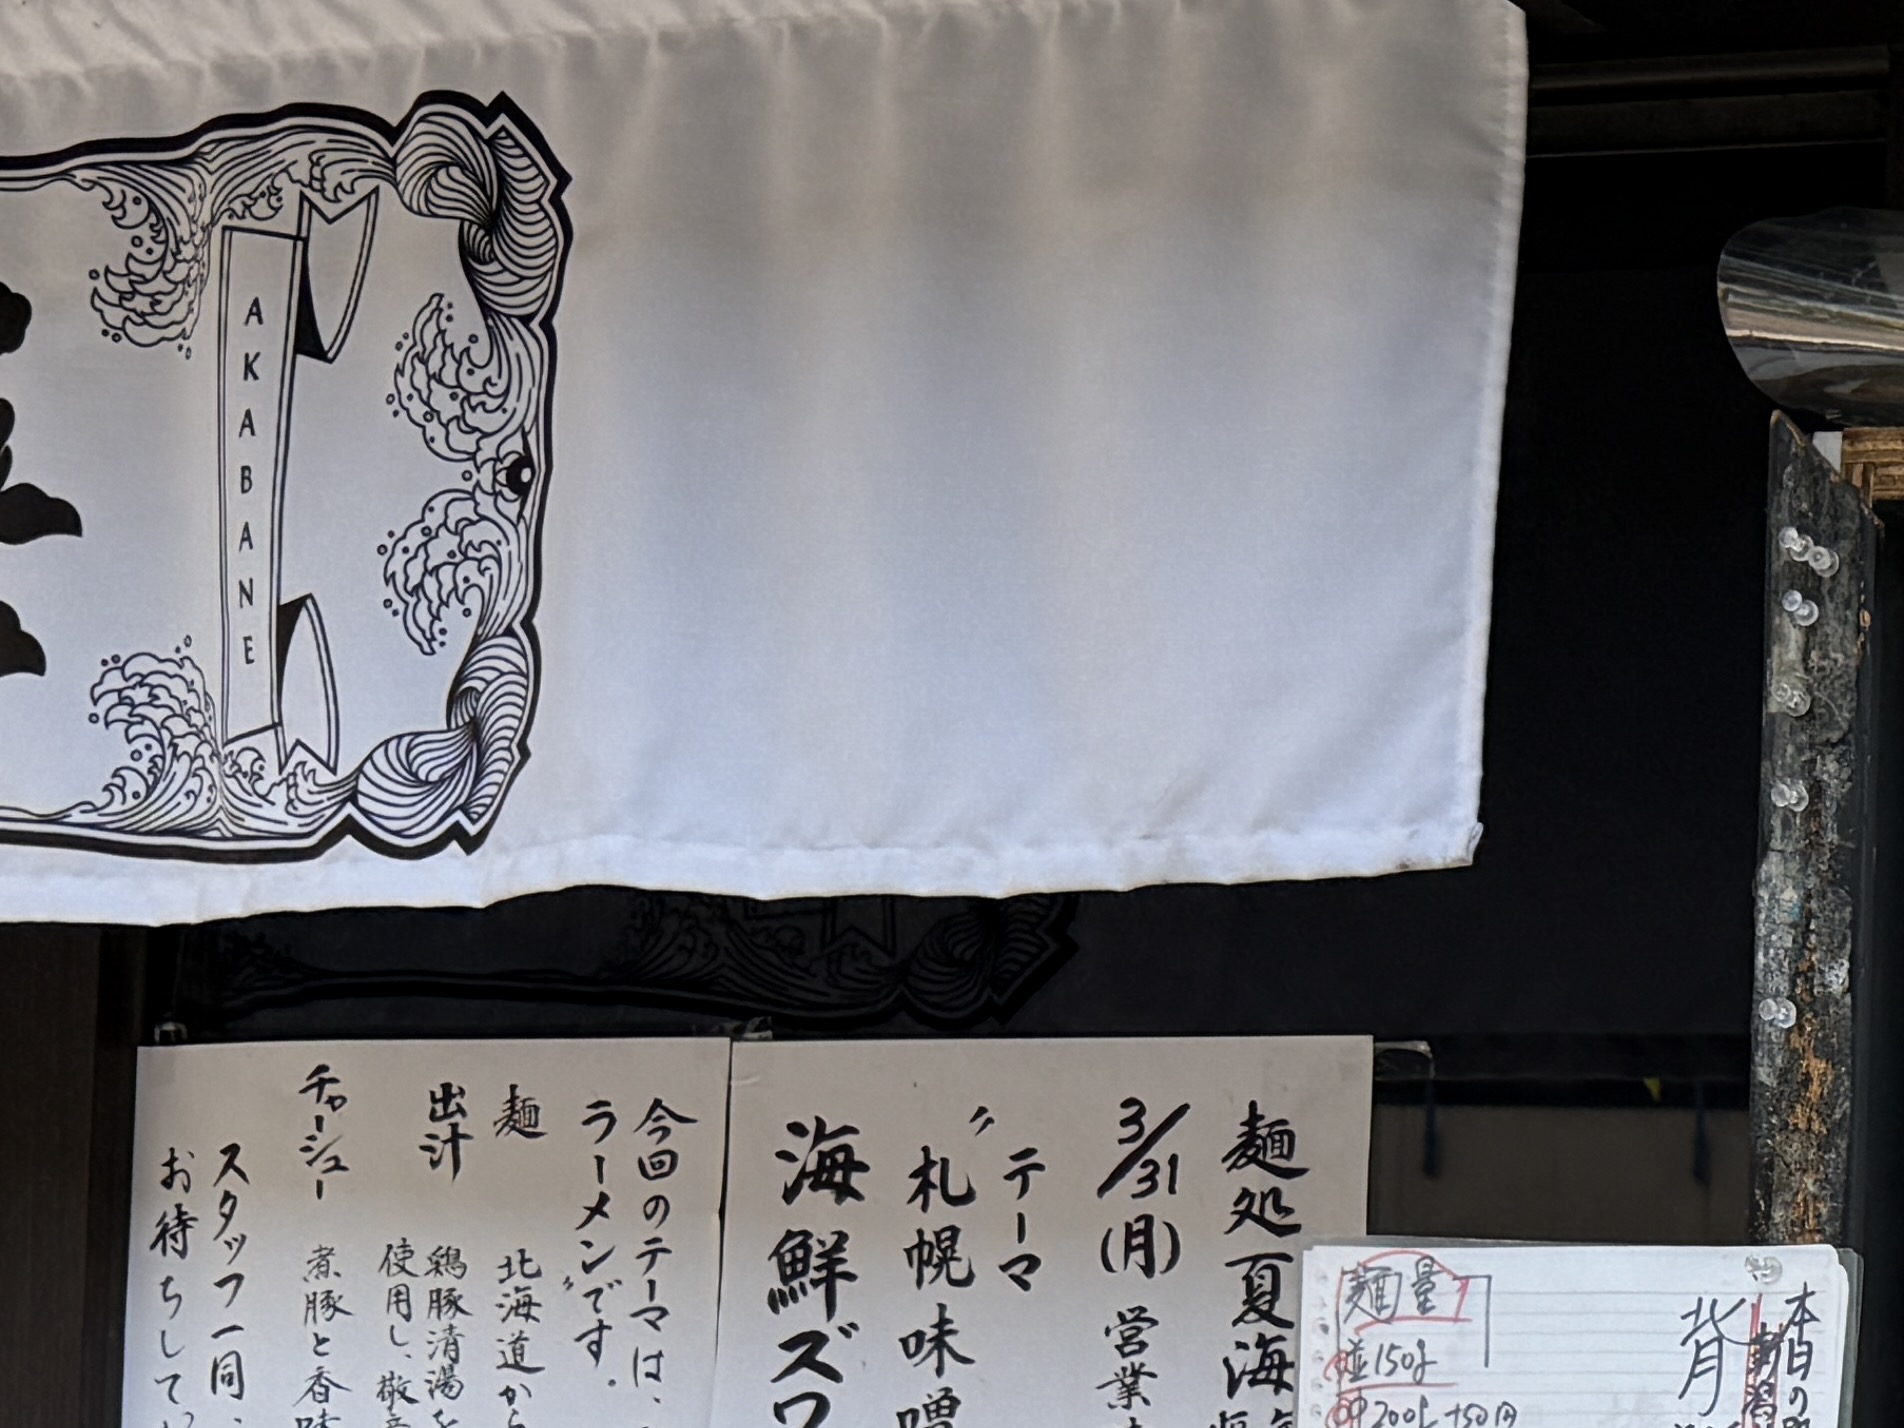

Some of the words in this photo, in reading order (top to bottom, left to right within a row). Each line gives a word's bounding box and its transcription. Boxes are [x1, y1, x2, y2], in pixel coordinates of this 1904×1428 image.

[238, 296, 265, 667] AKABANE
[303, 1063, 350, 1203] チャーシュー
[424, 1083, 472, 1181] 出汁
[493, 1084, 546, 1138] 麺
[999, 1148, 1046, 1293] テーマ
